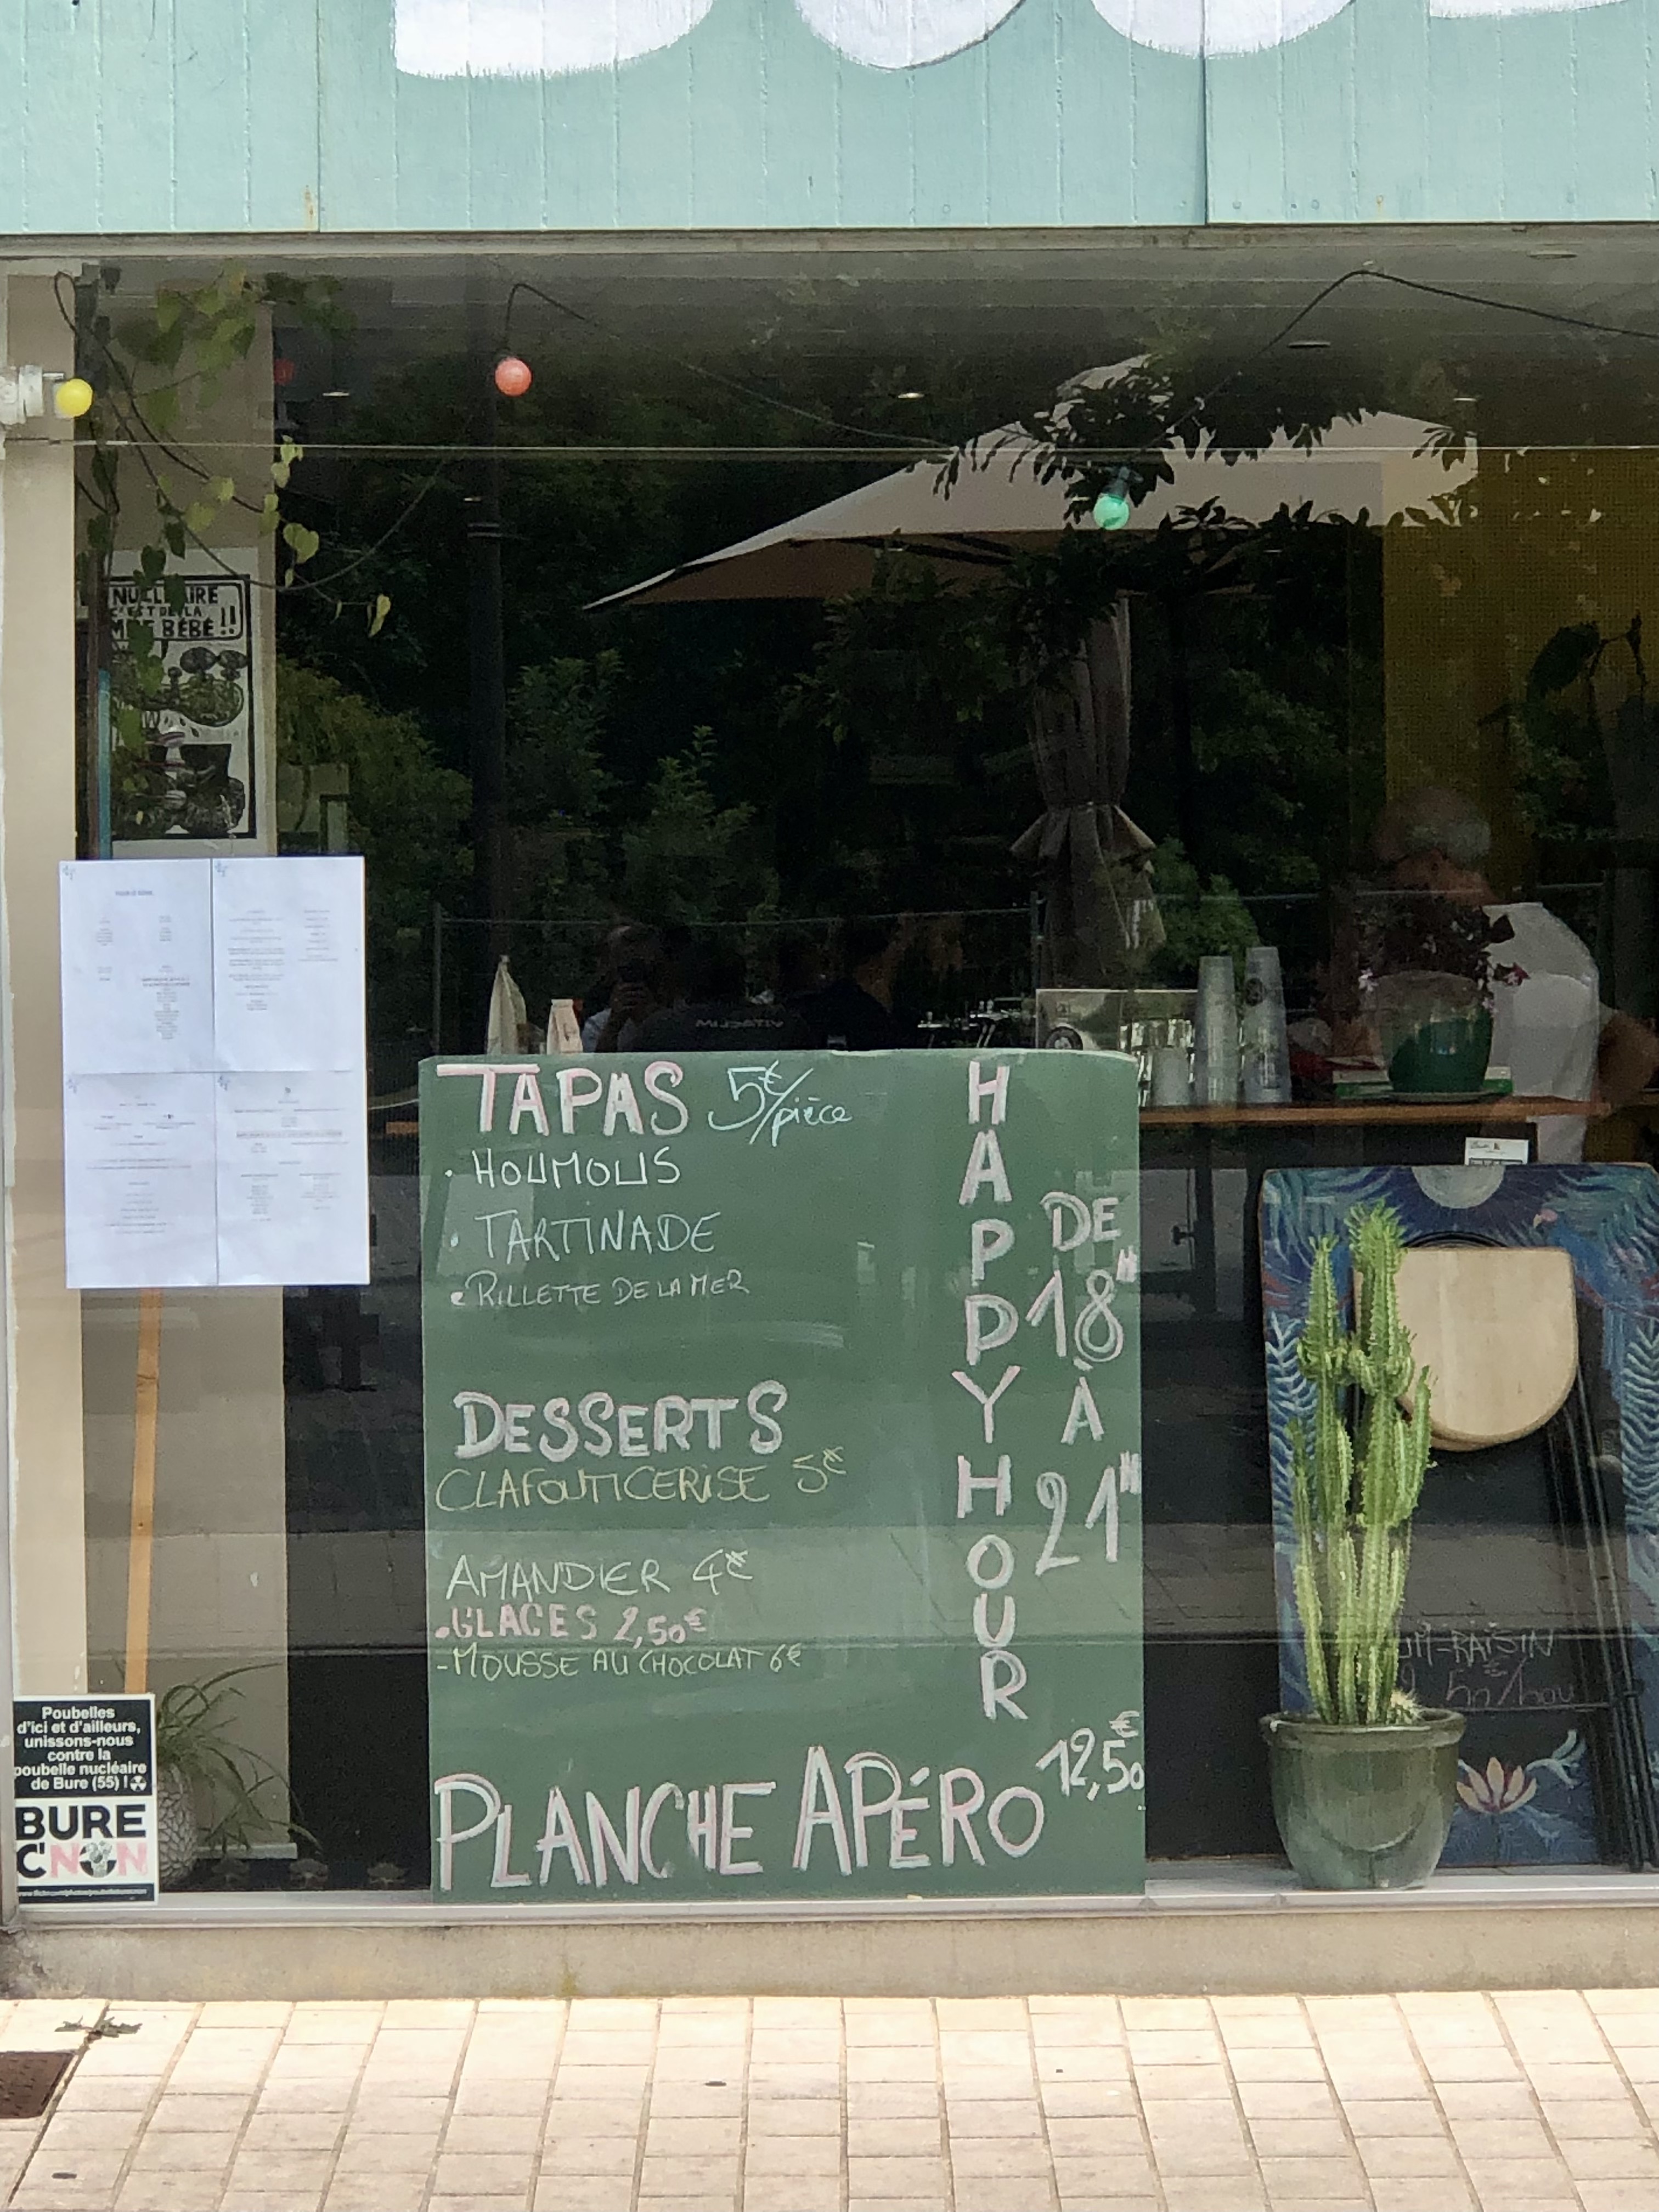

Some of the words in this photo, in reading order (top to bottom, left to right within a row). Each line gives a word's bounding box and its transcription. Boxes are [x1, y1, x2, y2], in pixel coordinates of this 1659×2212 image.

[162, 617, 215, 637] BÉBÉ
[437, 1061, 689, 1137] TAPAS
[472, 1147, 680, 1189] HOUMOUS
[475, 1209, 722, 1264] TARTINADE
[1041, 1190, 1121, 1252] DE
[951, 1060, 1022, 1443] HAPPY
[465, 1269, 602, 1308] RILLETTE
[612, 1278, 648, 1305] DE
[658, 1277, 684, 1299] LA
[690, 1269, 751, 1298] MER
[453, 1379, 788, 1462] DESSERTS
[792, 1446, 847, 1494] 5€
[445, 1554, 670, 1600] AMANDIER
[692, 1548, 754, 1596] 4€
[957, 1454, 1028, 1720] HOUR
[613, 1606, 707, 1650] 2,50€
[592, 1649, 629, 1677] AU
[639, 1648, 765, 1676] CHOCOLAT
[768, 1643, 803, 1673] 6€
[16, 1720, 48, 1734] d'ici
[51, 1722, 66, 1734] et
[69, 1720, 141, 1735] d'ailleurs,
[42, 1706, 115, 1719] Poubelles
[24, 1735, 134, 1749] unissons-nous
[47, 1750, 94, 1762] contre
[98, 1748, 112, 1761] la
[30, 1778, 49, 1791] de
[53, 1777, 89, 1790] Bure
[92, 1776, 120, 1792] (55)
[79, 1762, 148, 1776] nucléaire
[15, 1804, 146, 1841] BURE
[434, 1773, 777, 1892] PLANCHE
[792, 1745, 1044, 1876] APÉRO
